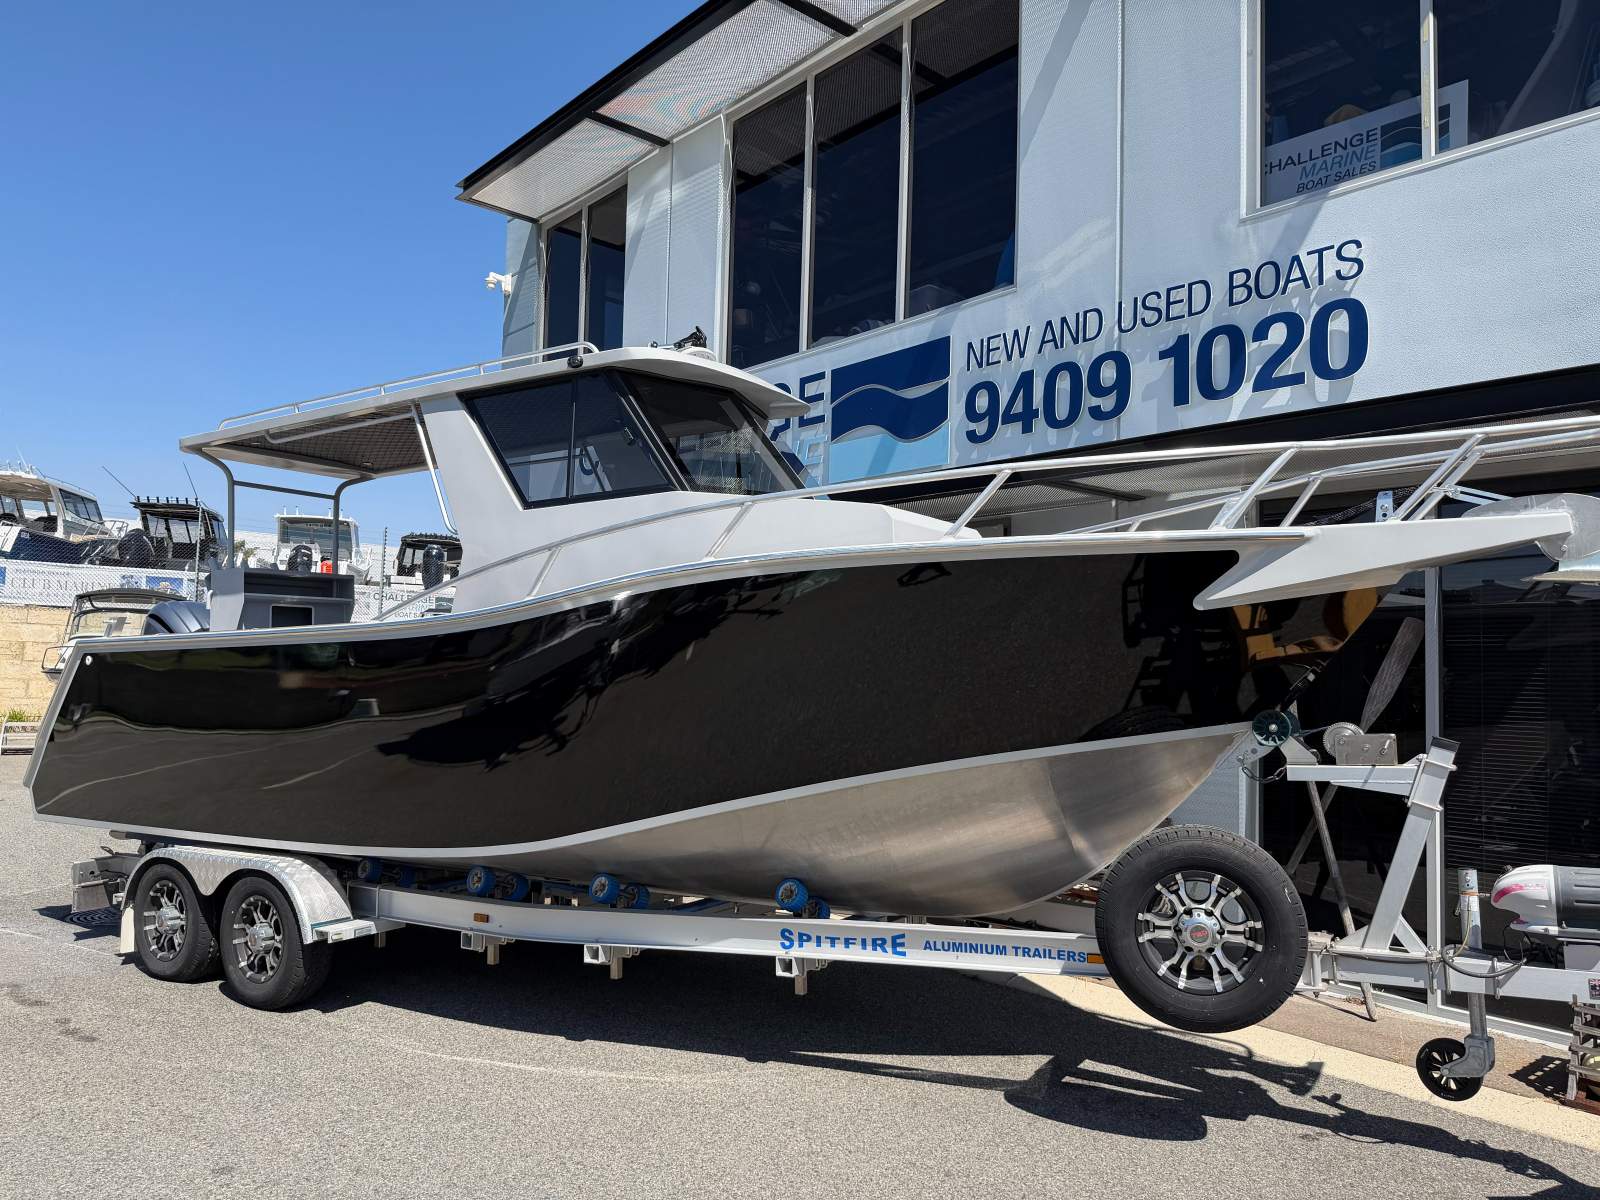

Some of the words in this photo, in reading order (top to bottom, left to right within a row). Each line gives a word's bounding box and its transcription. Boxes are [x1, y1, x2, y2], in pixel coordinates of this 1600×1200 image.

[1296, 175, 1331, 193] BOAT
[1334, 160, 1377, 181] SALES
[1300, 144, 1377, 181] MARINE
[966, 328, 1029, 372] NEW
[1038, 308, 1104, 354] AND
[1117, 279, 1211, 335] USED
[1228, 239, 1364, 307] BOATS
[965, 350, 1132, 445] 9409
[1158, 298, 1369, 408] 1020
[373, 592, 434, 604] CHALLEGE
[778, 927, 907, 958] SPITFIRE
[923, 939, 1008, 956] ALUMINIUM
[1011, 946, 1087, 963] TRAILERS
